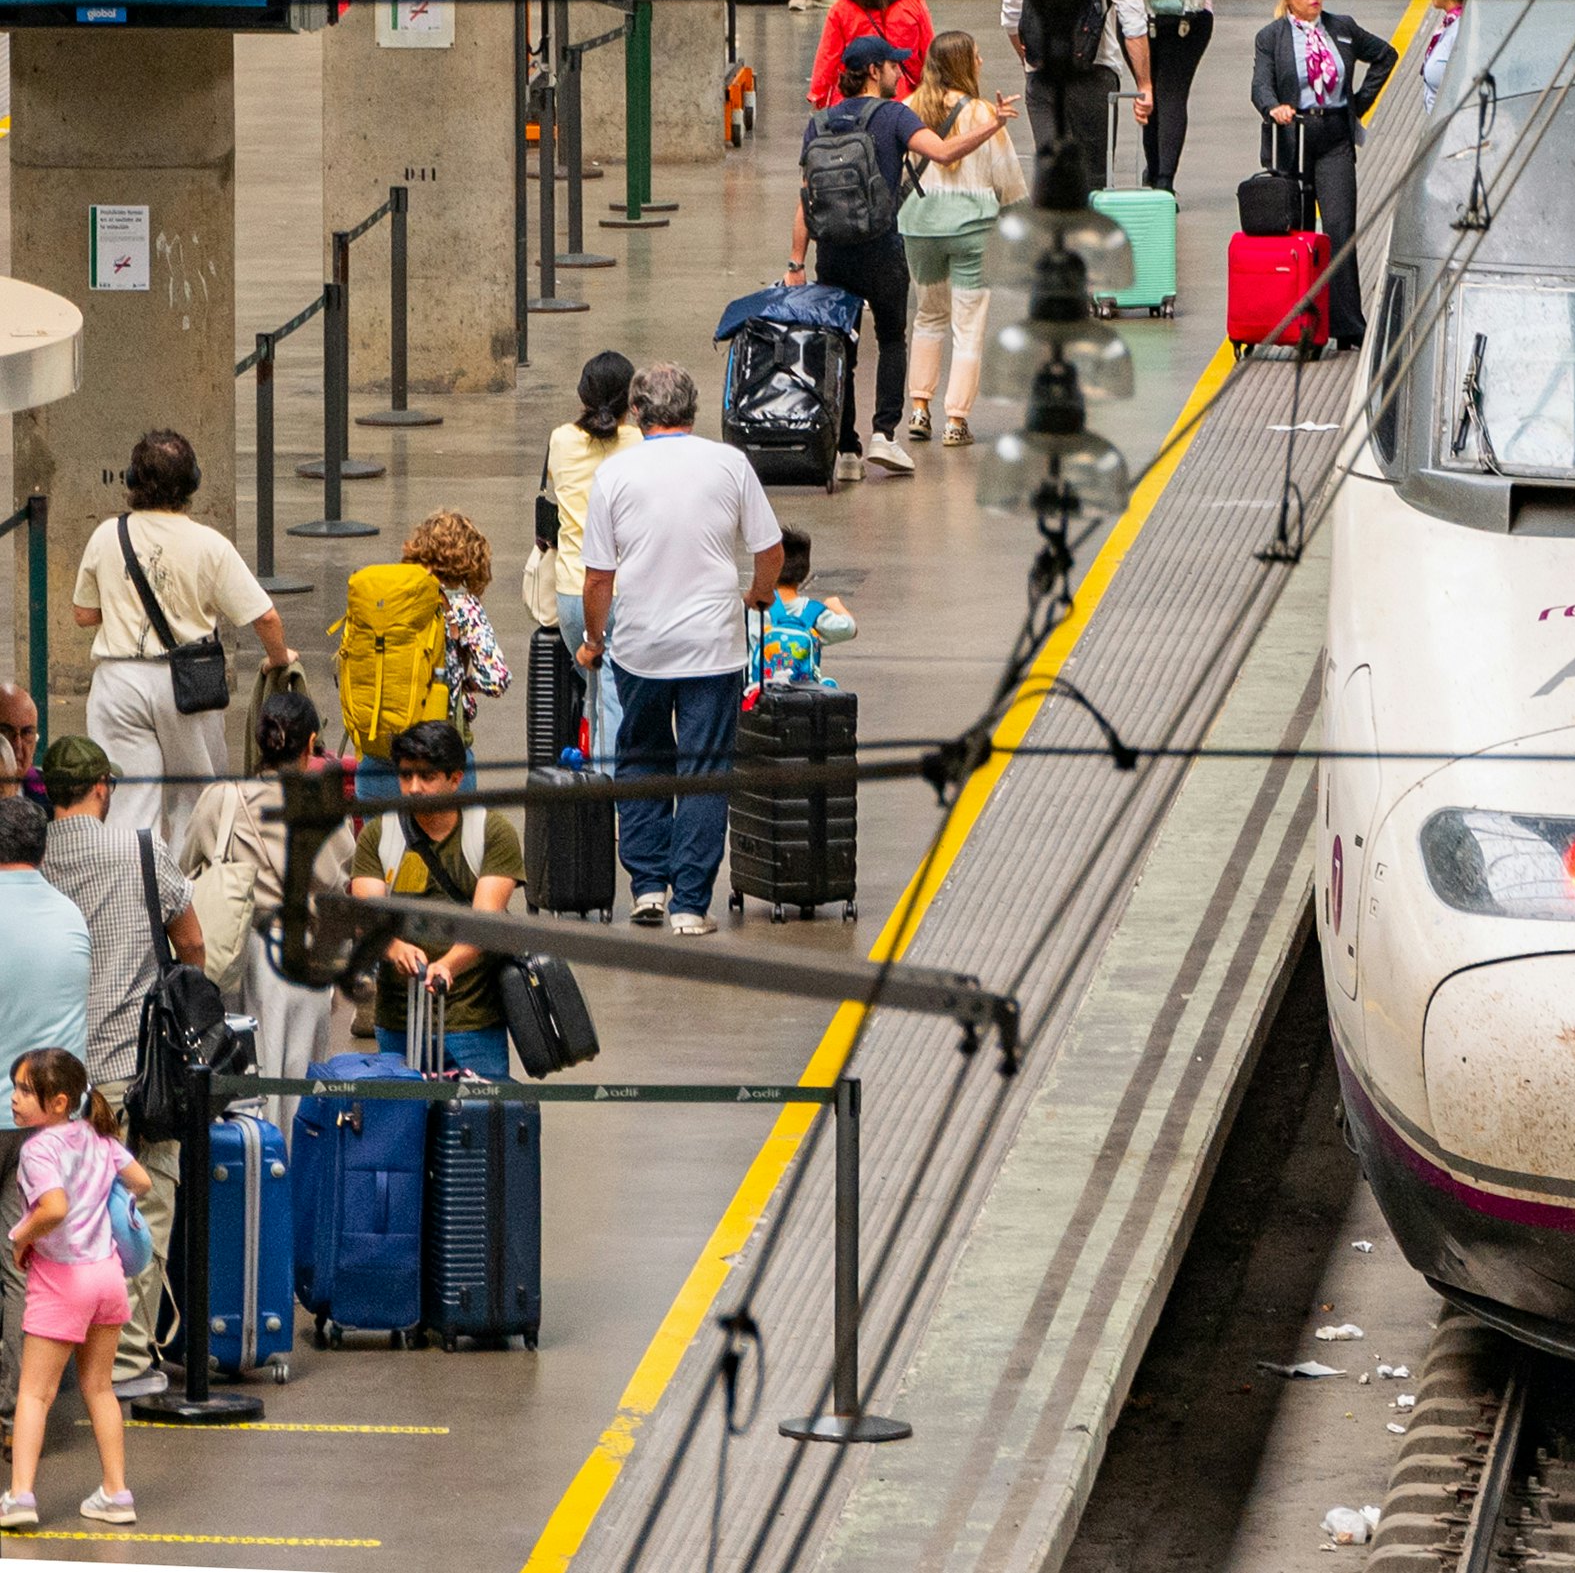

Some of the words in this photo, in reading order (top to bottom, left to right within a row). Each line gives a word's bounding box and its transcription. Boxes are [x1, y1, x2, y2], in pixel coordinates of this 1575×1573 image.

[86, 8, 117, 21] global
[327, 1081, 357, 1092] adif
[470, 1086, 501, 1096] adif
[609, 1087, 639, 1098] adif
[752, 1089, 780, 1099] adif
